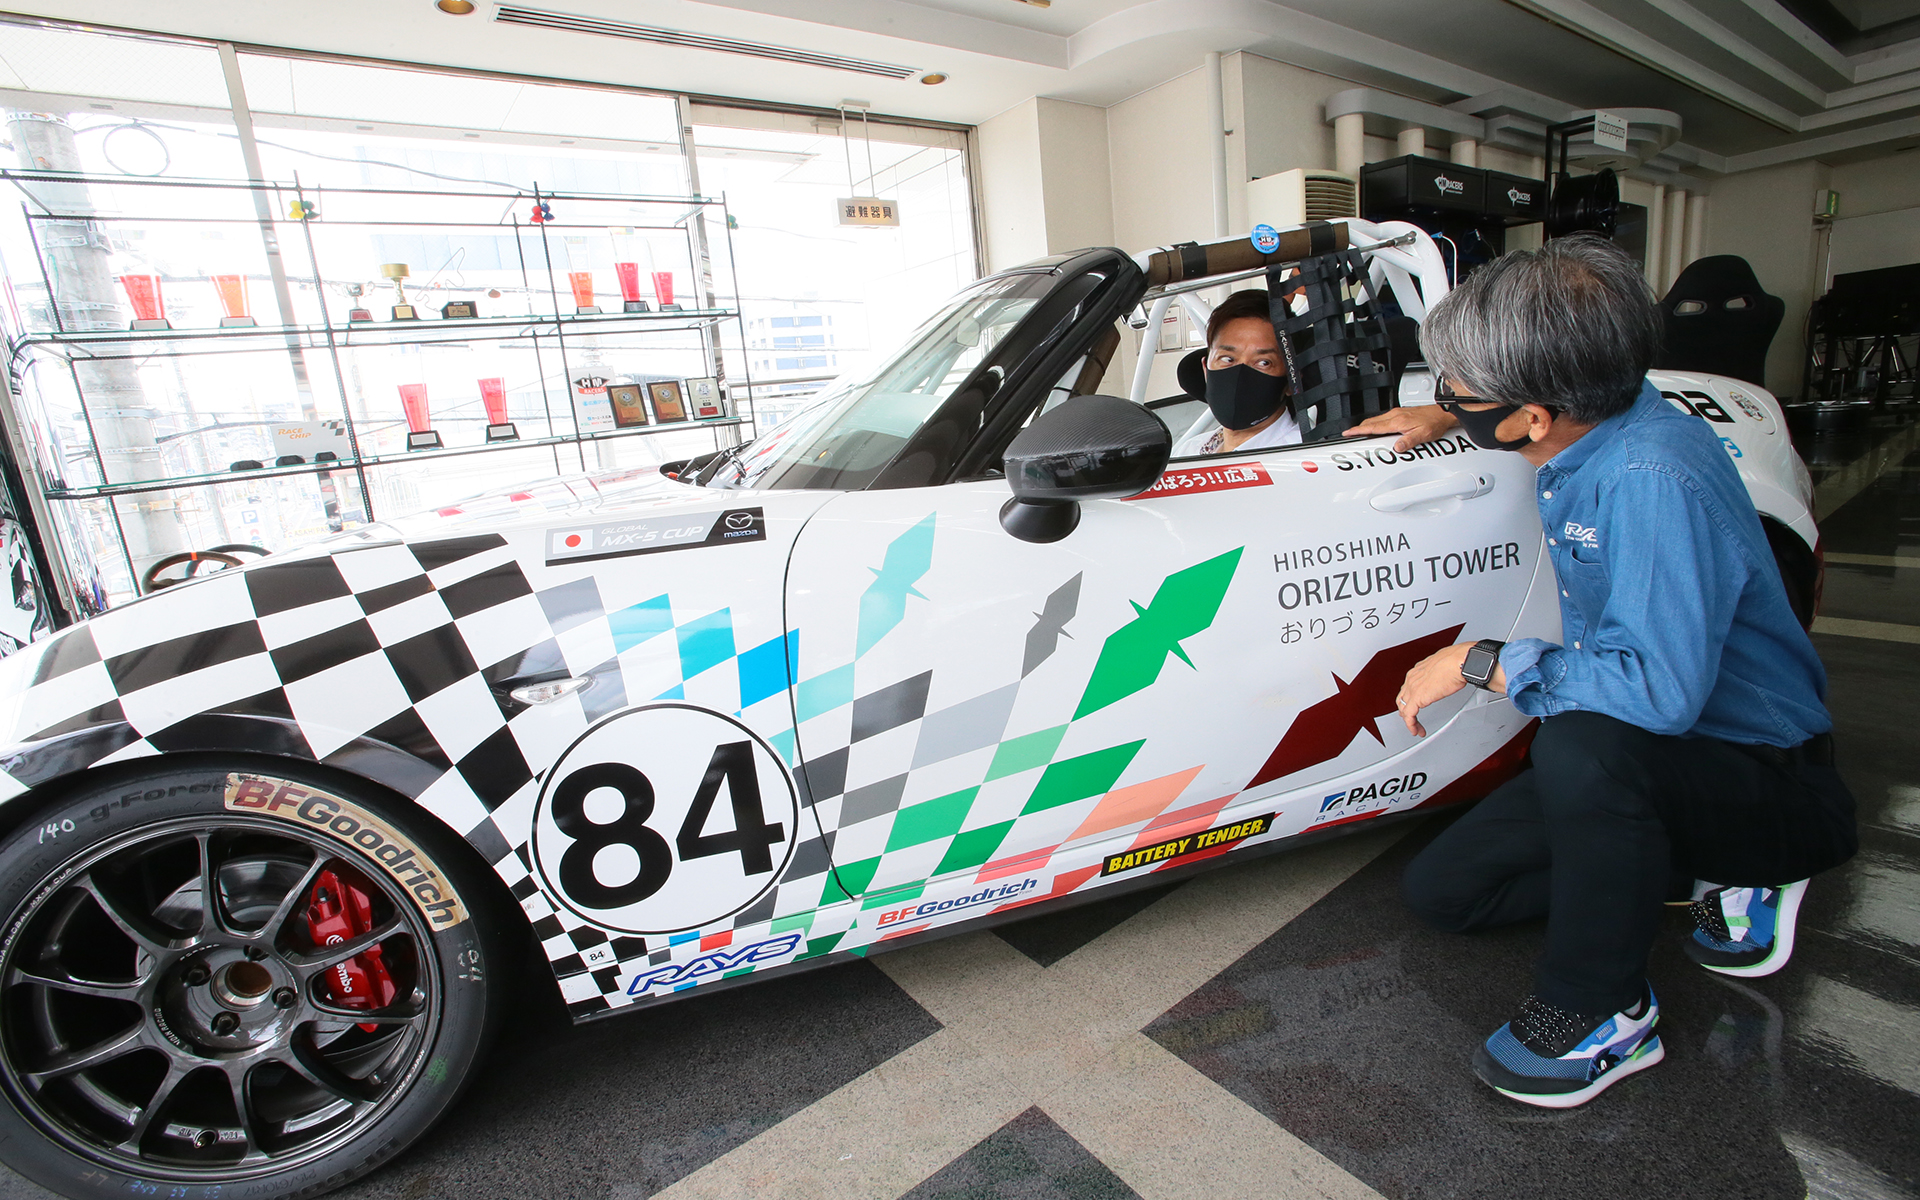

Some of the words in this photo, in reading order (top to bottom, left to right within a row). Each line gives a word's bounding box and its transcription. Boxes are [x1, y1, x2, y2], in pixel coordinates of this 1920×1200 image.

[845, 205, 892, 219] 避難器具
[1279, 329, 1297, 384] SAFECRAFT
[581, 377, 602, 388] HM
[583, 387, 605, 395] RACERS
[278, 427, 304, 436] RACE
[289, 432, 312, 440] CHIP
[601, 524, 648, 535] GLOBAL
[601, 530, 657, 547] MX-5
[662, 525, 704, 539] CUP
[723, 528, 759, 539] mazda
[1273, 532, 1411, 573] HIROSHIMA
[1278, 560, 1415, 611] ORIZURU
[1424, 541, 1521, 583] TOWER
[1280, 597, 1452, 645] おりづるタワー
[1346, 772, 1428, 806] PAGID
[1315, 792, 1421, 823] RACING
[38, 818, 76, 845] 140
[551, 739, 786, 911] 84
[233, 778, 457, 925] BFGoodrich
[1108, 838, 1191, 873] BATTERY
[4, 911, 30, 947] GLOBAL
[30, 885, 52, 908] MX-5
[53, 867, 72, 885] CUP
[877, 878, 1038, 926] BFGoodrich
[589, 950, 605, 961] 84
[626, 933, 802, 996] RAYS
[336, 962, 353, 994] embo
[391, 1081, 406, 1100] MADE
[411, 1049, 426, 1073] JAPAN
